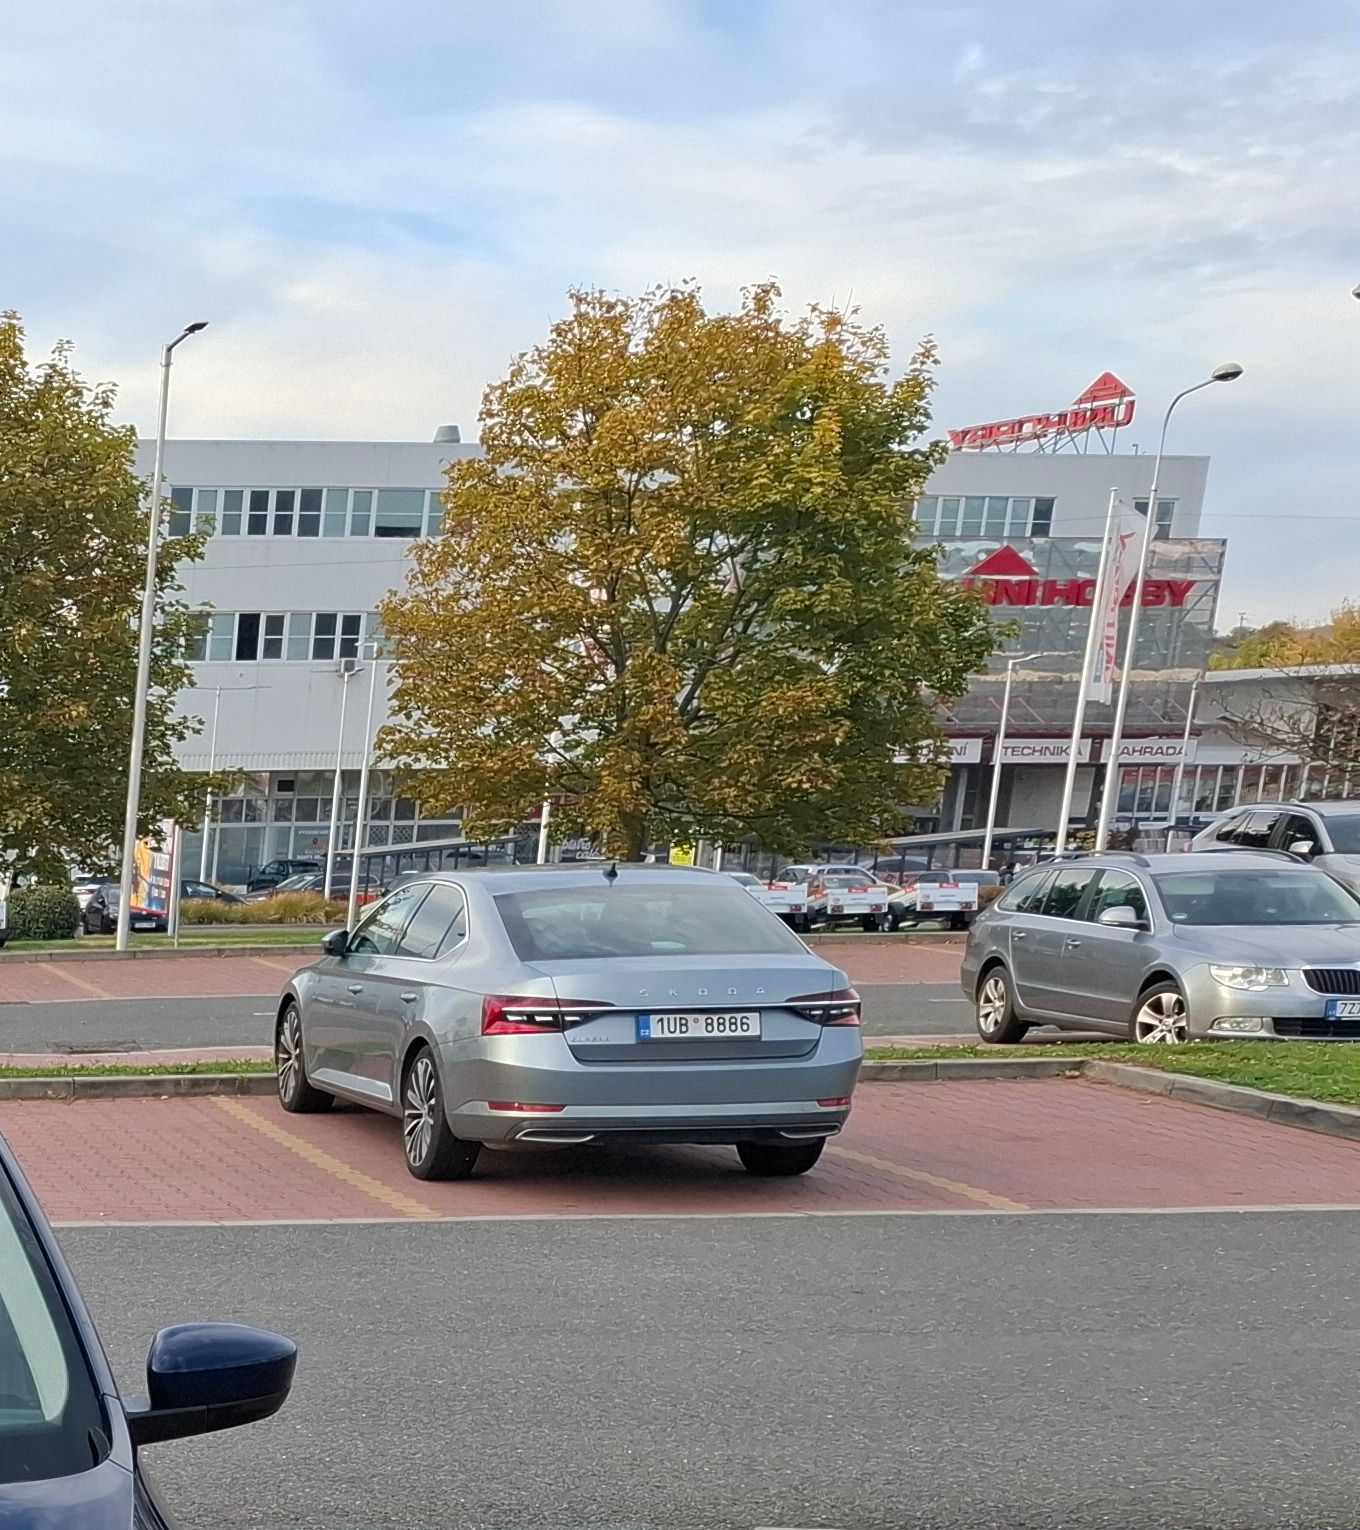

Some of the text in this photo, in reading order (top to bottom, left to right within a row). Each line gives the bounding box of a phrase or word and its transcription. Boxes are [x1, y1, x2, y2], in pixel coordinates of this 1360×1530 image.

[1114, 745, 1188, 757] AHRADA
[1339, 1002, 1360, 1015] 7Z
[656, 1016, 690, 1035] 1UB
[704, 1015, 751, 1034] 8886
